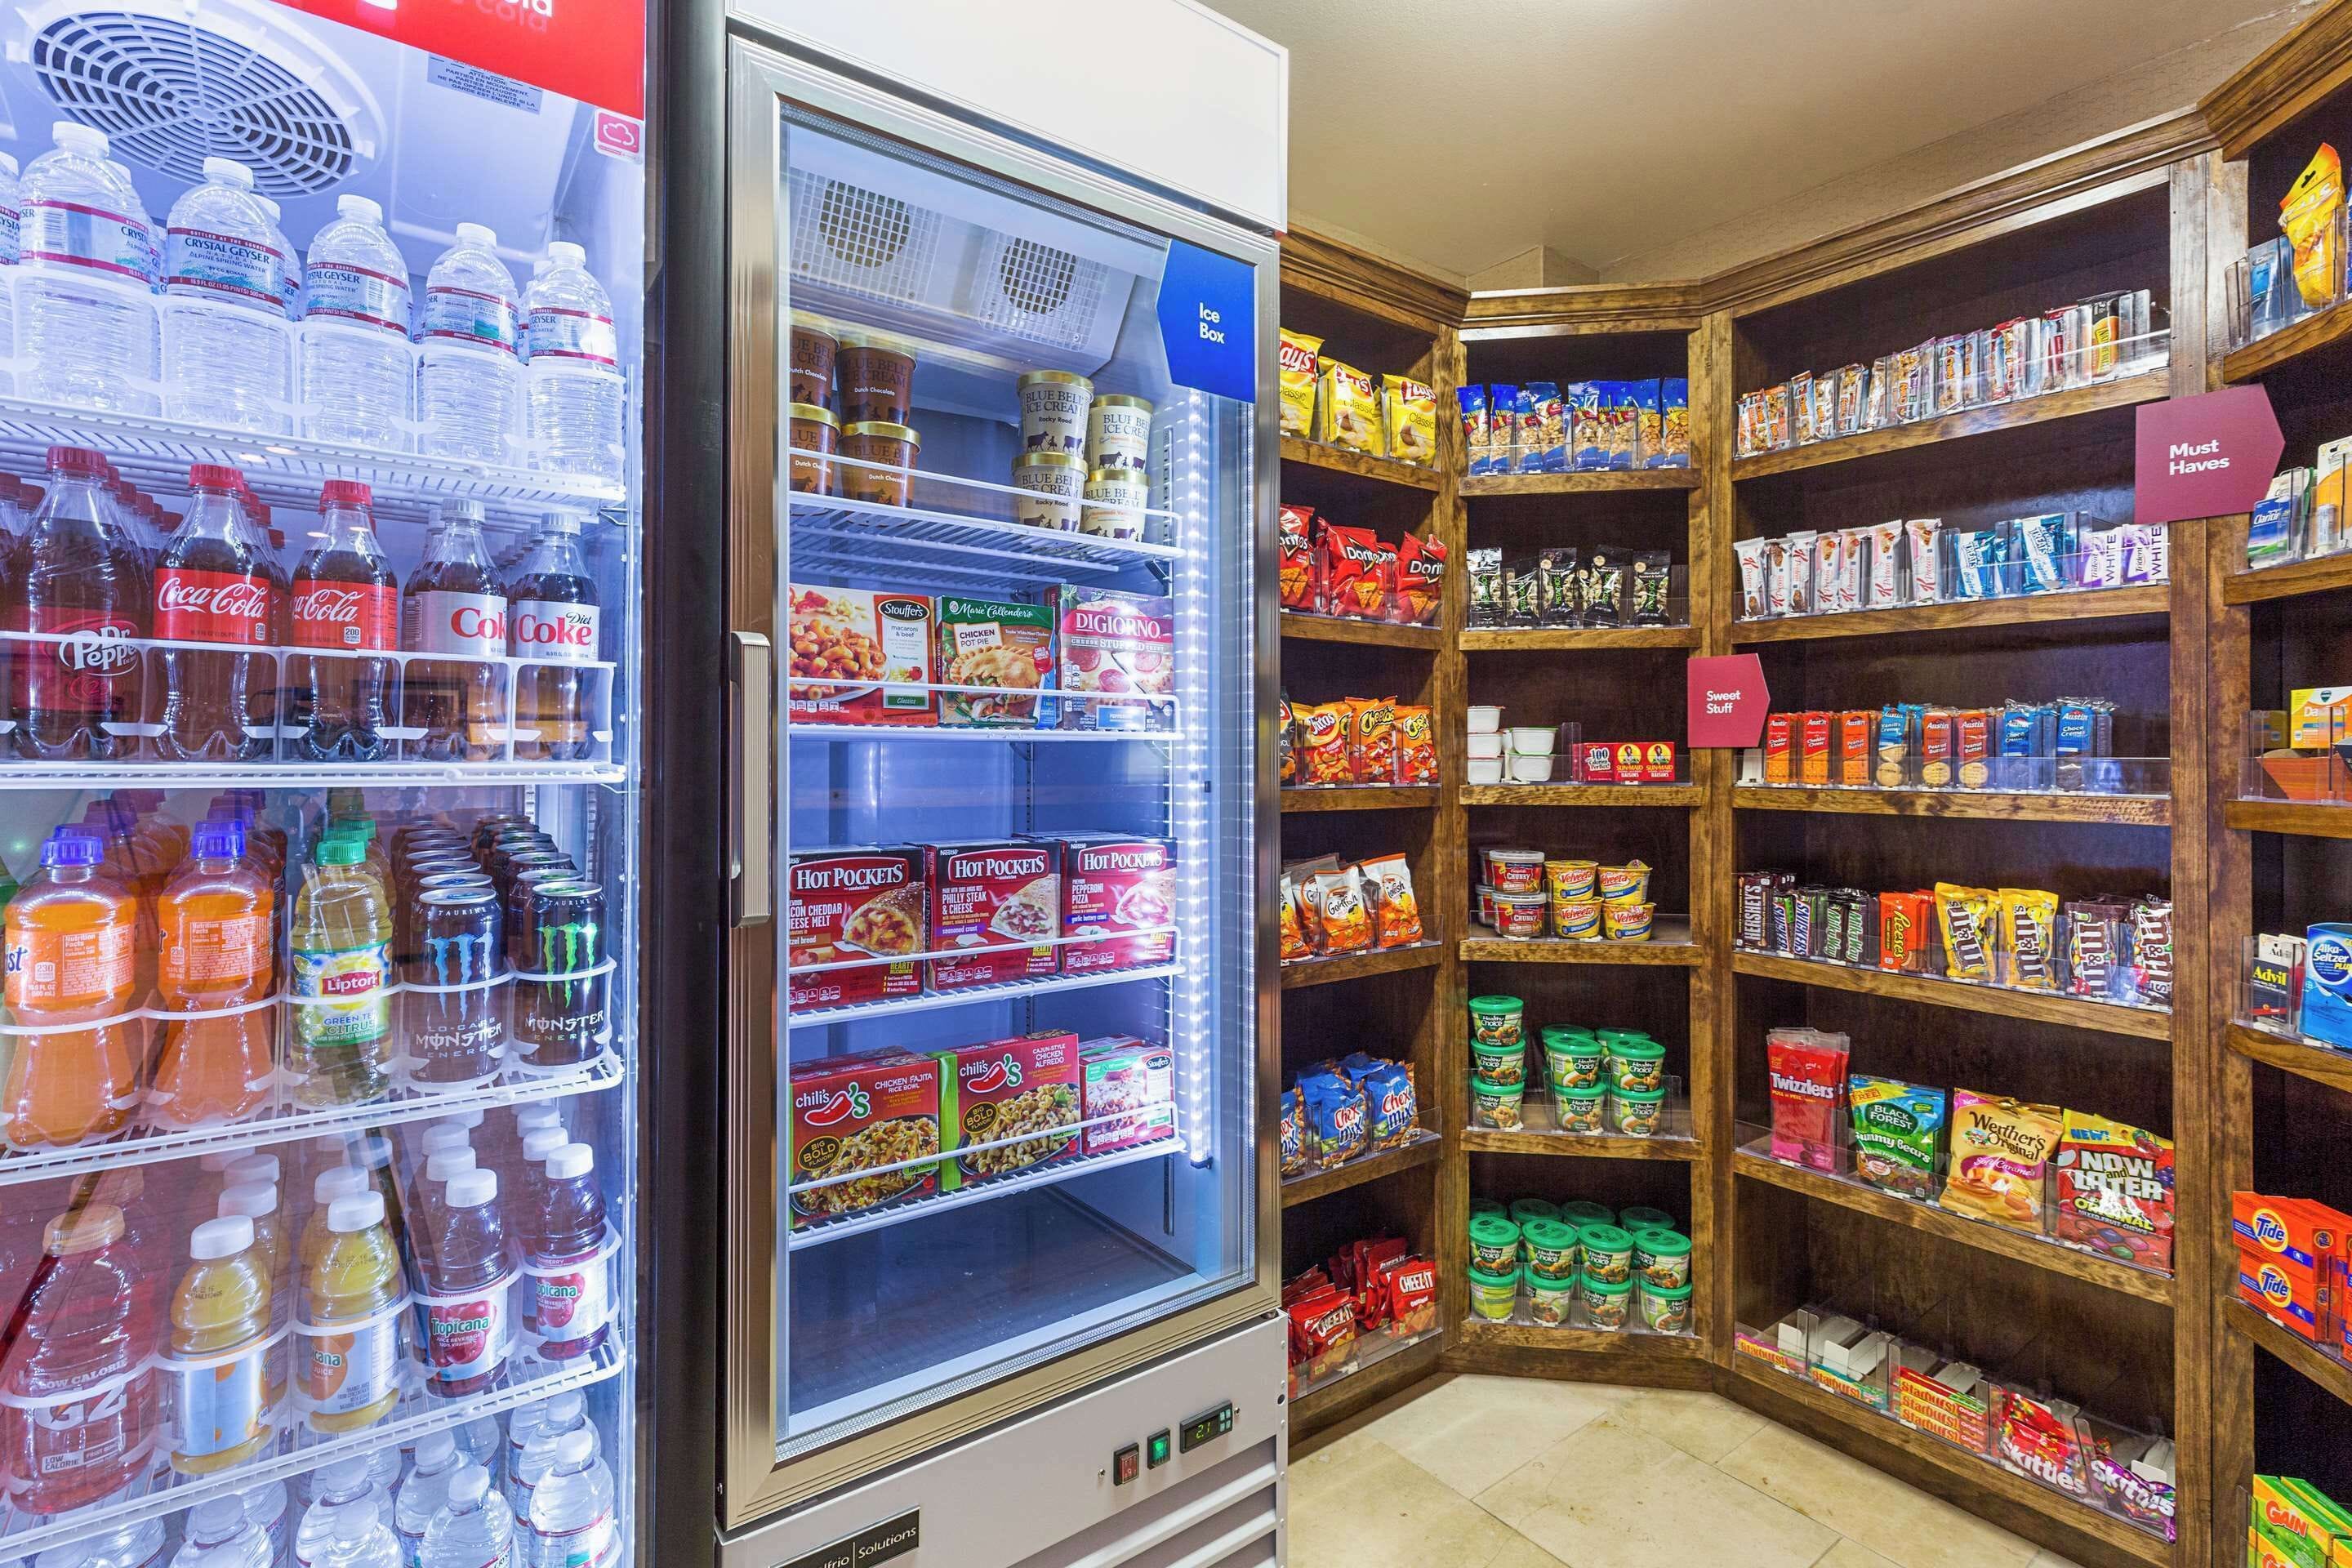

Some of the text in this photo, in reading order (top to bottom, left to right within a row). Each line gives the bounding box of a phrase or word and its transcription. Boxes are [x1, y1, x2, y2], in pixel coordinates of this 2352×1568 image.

[185, 237, 270, 265] CRYSTAL GEYSER
[189, 251, 215, 262] ALPINE
[216, 256, 243, 267] SPRING
[324, 271, 360, 284] GEYSER
[1199, 301, 1220, 324] Ice
[1199, 321, 1225, 345] Box
[870, 386, 895, 396] Chocolate
[1026, 390, 1055, 403] BLUE
[1026, 401, 1083, 416] ICE CREAM
[1058, 416, 1072, 425] Road
[1104, 425, 1121, 434] ICE
[2169, 439, 2220, 460] Must
[2169, 457, 2230, 476] Haves
[1022, 474, 1052, 484] BLUE
[1054, 499, 1069, 507] Road
[2105, 533, 2117, 582] WHITE
[2151, 526, 2163, 576] WHITE
[158, 577, 268, 618] Coca-Cola
[566, 612, 592, 624] Diet
[884, 604, 924, 617] Stouffer's
[956, 602, 1033, 619] Marie Callender's
[519, 614, 592, 645] Coke
[1076, 612, 1160, 639] DIGIORNO
[960, 629, 995, 639] CHICKEN
[1705, 689, 1741, 702] Sweet
[1705, 702, 1734, 714] Stuff
[1961, 720, 1984, 728] Austin
[2062, 712, 2088, 721] Austin
[1927, 722, 1950, 730] Austin
[1591, 749, 1608, 760] 100
[955, 854, 1045, 879] HOT POCKETS
[1084, 849, 1162, 871] HOT POCKETS
[796, 864, 904, 889] HOT POCKETS
[1561, 870, 1593, 883] Velveeta
[1072, 883, 1103, 894] PEPPERONI
[942, 891, 987, 904] PHILLY STEAK
[1072, 894, 1089, 904] PIZZA
[438, 906, 487, 916] TAURINE
[808, 902, 842, 915] CHEDDAR
[942, 902, 973, 915] & CHEESE
[1561, 907, 1594, 920] Velveeta
[1744, 884, 1762, 941] HERSHEY'S
[812, 915, 830, 928] MELT
[1616, 911, 1648, 924] Velveeta
[1794, 900, 1811, 956] SNICKERS
[2315, 943, 2344, 953] Alka-
[2313, 952, 2350, 962] Seltzer
[327, 975, 376, 992] Lipton
[2252, 966, 2287, 986] Advil
[324, 1015, 359, 1026] GREEN
[327, 1019, 374, 1034] CITRUS
[524, 1009, 604, 1034] MONSTER
[425, 1040, 497, 1058] ENERGY
[1032, 1043, 1066, 1054] CAJUN-STYLE
[1036, 1050, 1063, 1060] CHICKEN
[960, 1060, 989, 1077] chili's
[1035, 1057, 1064, 1068] ALFREDO
[875, 1073, 933, 1089] CHICKEN FAJITA
[903, 1083, 920, 1092] BOWL
[1770, 1071, 1834, 1099] Twizzlers
[795, 1089, 831, 1108] chili's
[1383, 1086, 1410, 1113] Chex
[966, 1107, 994, 1126] BOLD
[972, 1107, 984, 1116] BIG
[1335, 1104, 1360, 1129] Chex
[1873, 1104, 1909, 1122] BLACK
[1869, 1111, 1913, 1130] FOREST
[1969, 1111, 2047, 1152] Werther's
[2070, 1129, 2111, 1141] NEW!
[803, 1143, 836, 1163] BOLD
[811, 1140, 826, 1151] BIG
[1897, 1137, 1931, 1164] Bears
[1986, 1131, 2042, 1162] Original
[2079, 1149, 2155, 1178] NOW
[2105, 1168, 2128, 1180] and
[2073, 1168, 2164, 1202] LATER
[2256, 1216, 2285, 1242] Tide
[1399, 1271, 1433, 1294] CHEEZ-IT
[2261, 1270, 2288, 1296] Tide
[431, 1316, 490, 1337] Tropicana
[45, 1454, 64, 1465] LOW
[45, 1459, 79, 1471] CALORIE
[2000, 1437, 2087, 1495] Skittles
[2266, 1500, 2308, 1538] GAIN
[858, 1527, 916, 1559] Solutions
